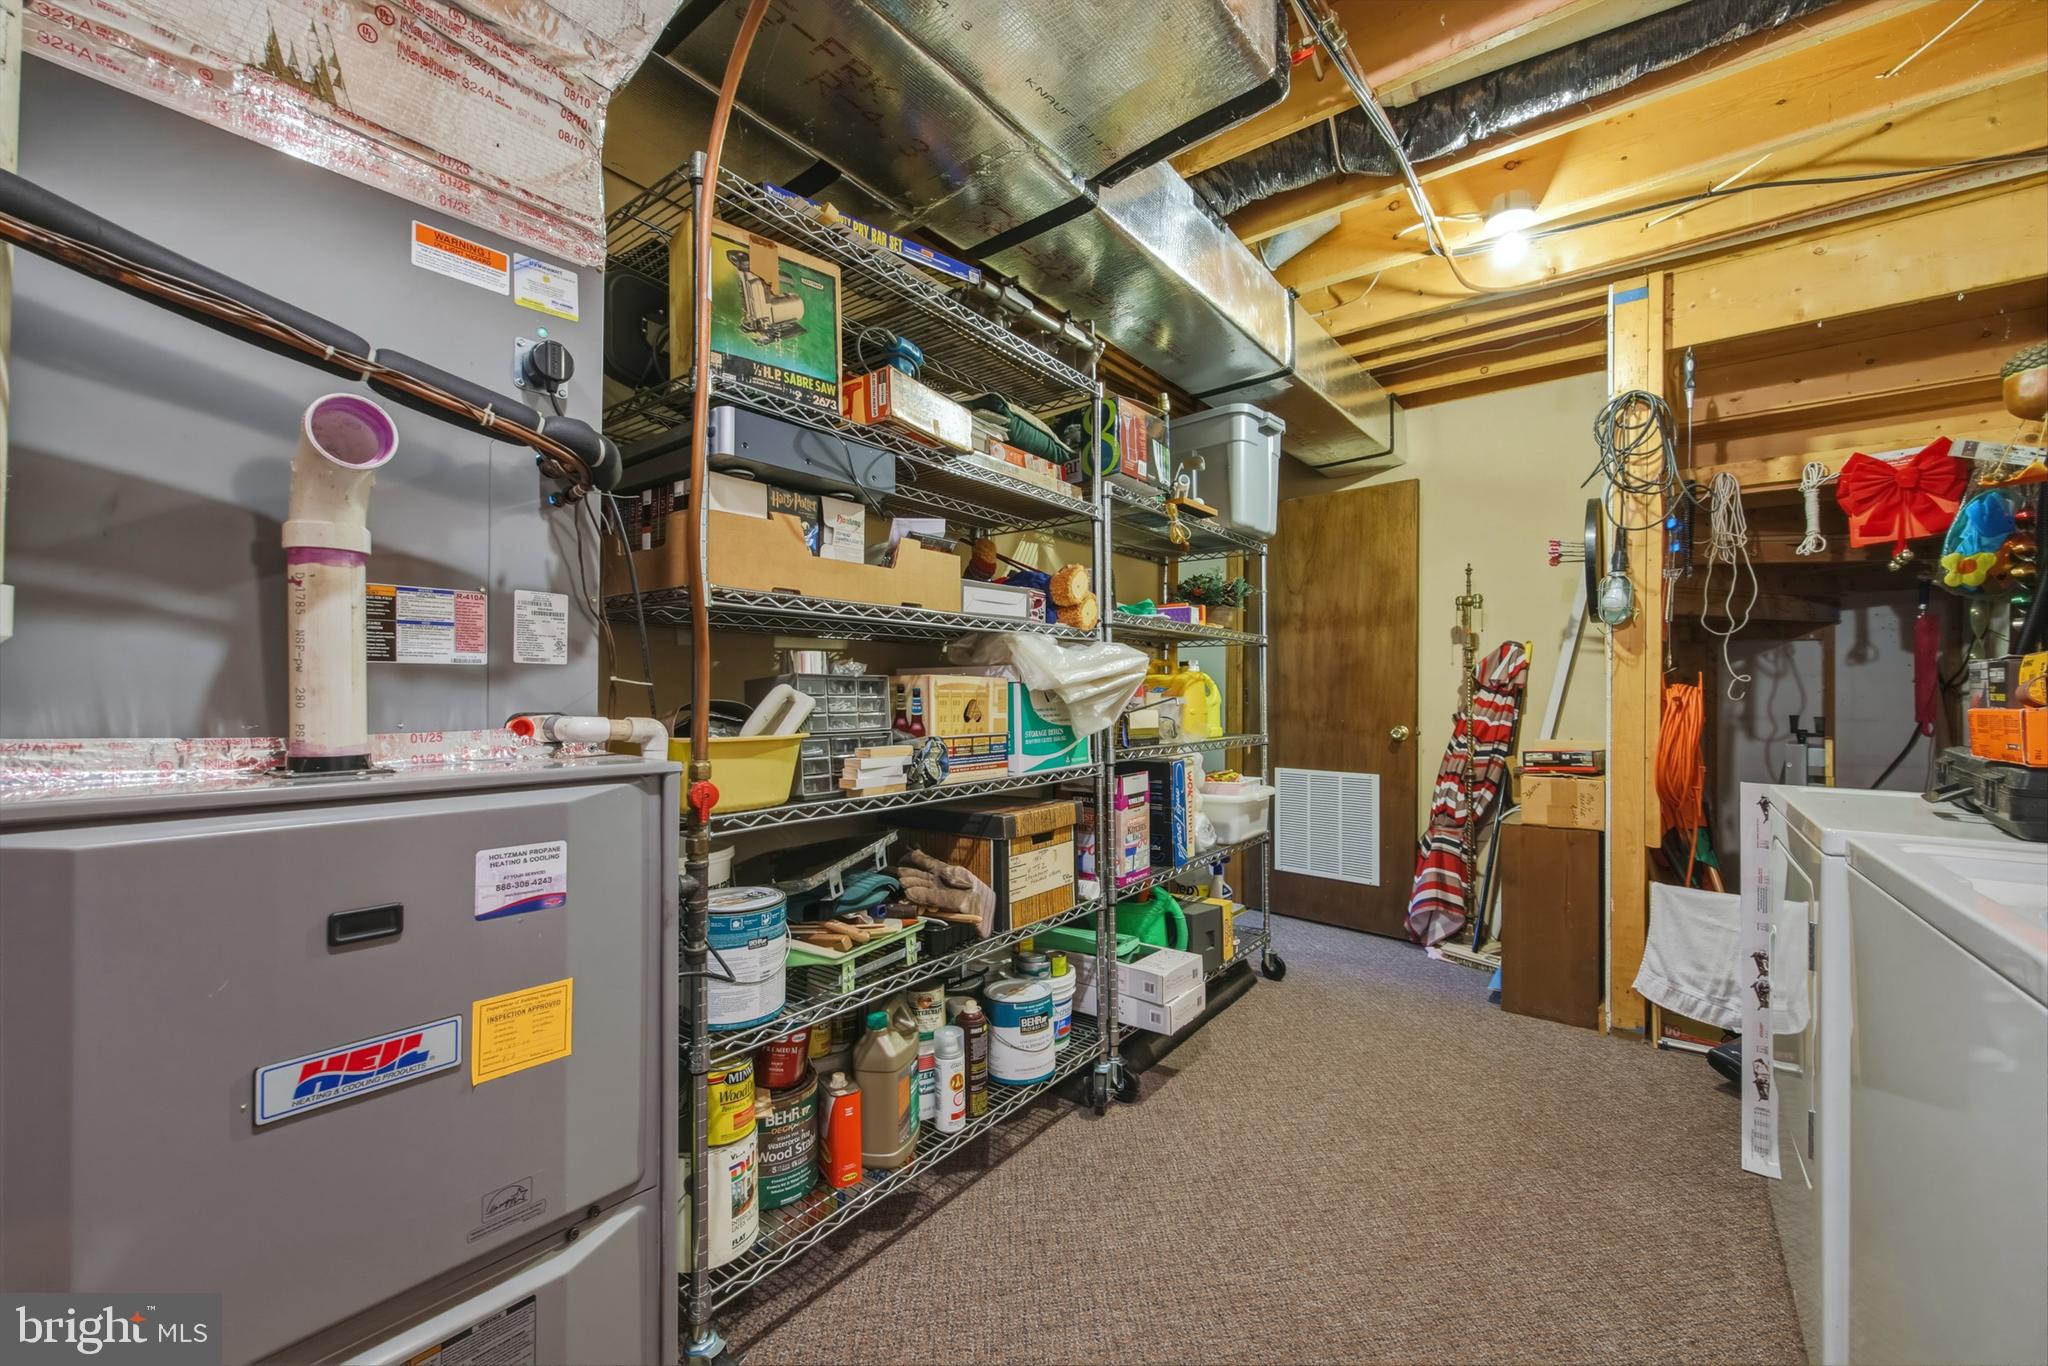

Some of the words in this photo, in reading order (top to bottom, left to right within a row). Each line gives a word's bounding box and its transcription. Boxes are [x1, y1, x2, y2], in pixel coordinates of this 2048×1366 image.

[37, 2, 93, 32] 324A
[36, 30, 93, 62] 324A
[466, 30, 499, 55] 324A
[397, 41, 460, 79] Nashua
[462, 77, 494, 102] 324A
[465, 54, 498, 81] 324A
[529, 54, 558, 79] 324A
[563, 86, 591, 109] 08/10
[1025, 76, 1074, 118] KNAUF
[557, 129, 586, 150] 08/10
[439, 174, 471, 194] 01/25
[438, 194, 471, 216] 01/25
[433, 231, 485, 258] WARNING
[853, 219, 870, 239] PRY
[871, 227, 888, 247] BAR
[888, 235, 904, 253] SET
[783, 372, 814, 391] SABRE
[815, 381, 836, 397] SAW
[812, 395, 837, 411] 2673
[771, 490, 794, 509] Harry
[456, 592, 485, 602] R-410A
[295, 687, 306, 710] 280
[295, 723, 306, 745] PSI
[410, 732, 443, 745] 01/25
[489, 850, 527, 861] HOLTZMAN
[528, 846, 561, 856] PROPANE
[490, 858, 521, 869] HEATING
[529, 853, 560, 863] COOLING
[487, 1008, 526, 1024] INSPECTION
[527, 999, 561, 1014] APPROVED
[1020, 1015, 1042, 1028] BEHR
[292, 1032, 430, 1100] HEIL
[292, 1090, 333, 1107] HEATING
[341, 1076, 381, 1093] COOLING
[382, 1062, 427, 1081] PRODUCTS
[765, 1105, 800, 1128] BEHR
[732, 1232, 746, 1247] FLAT
